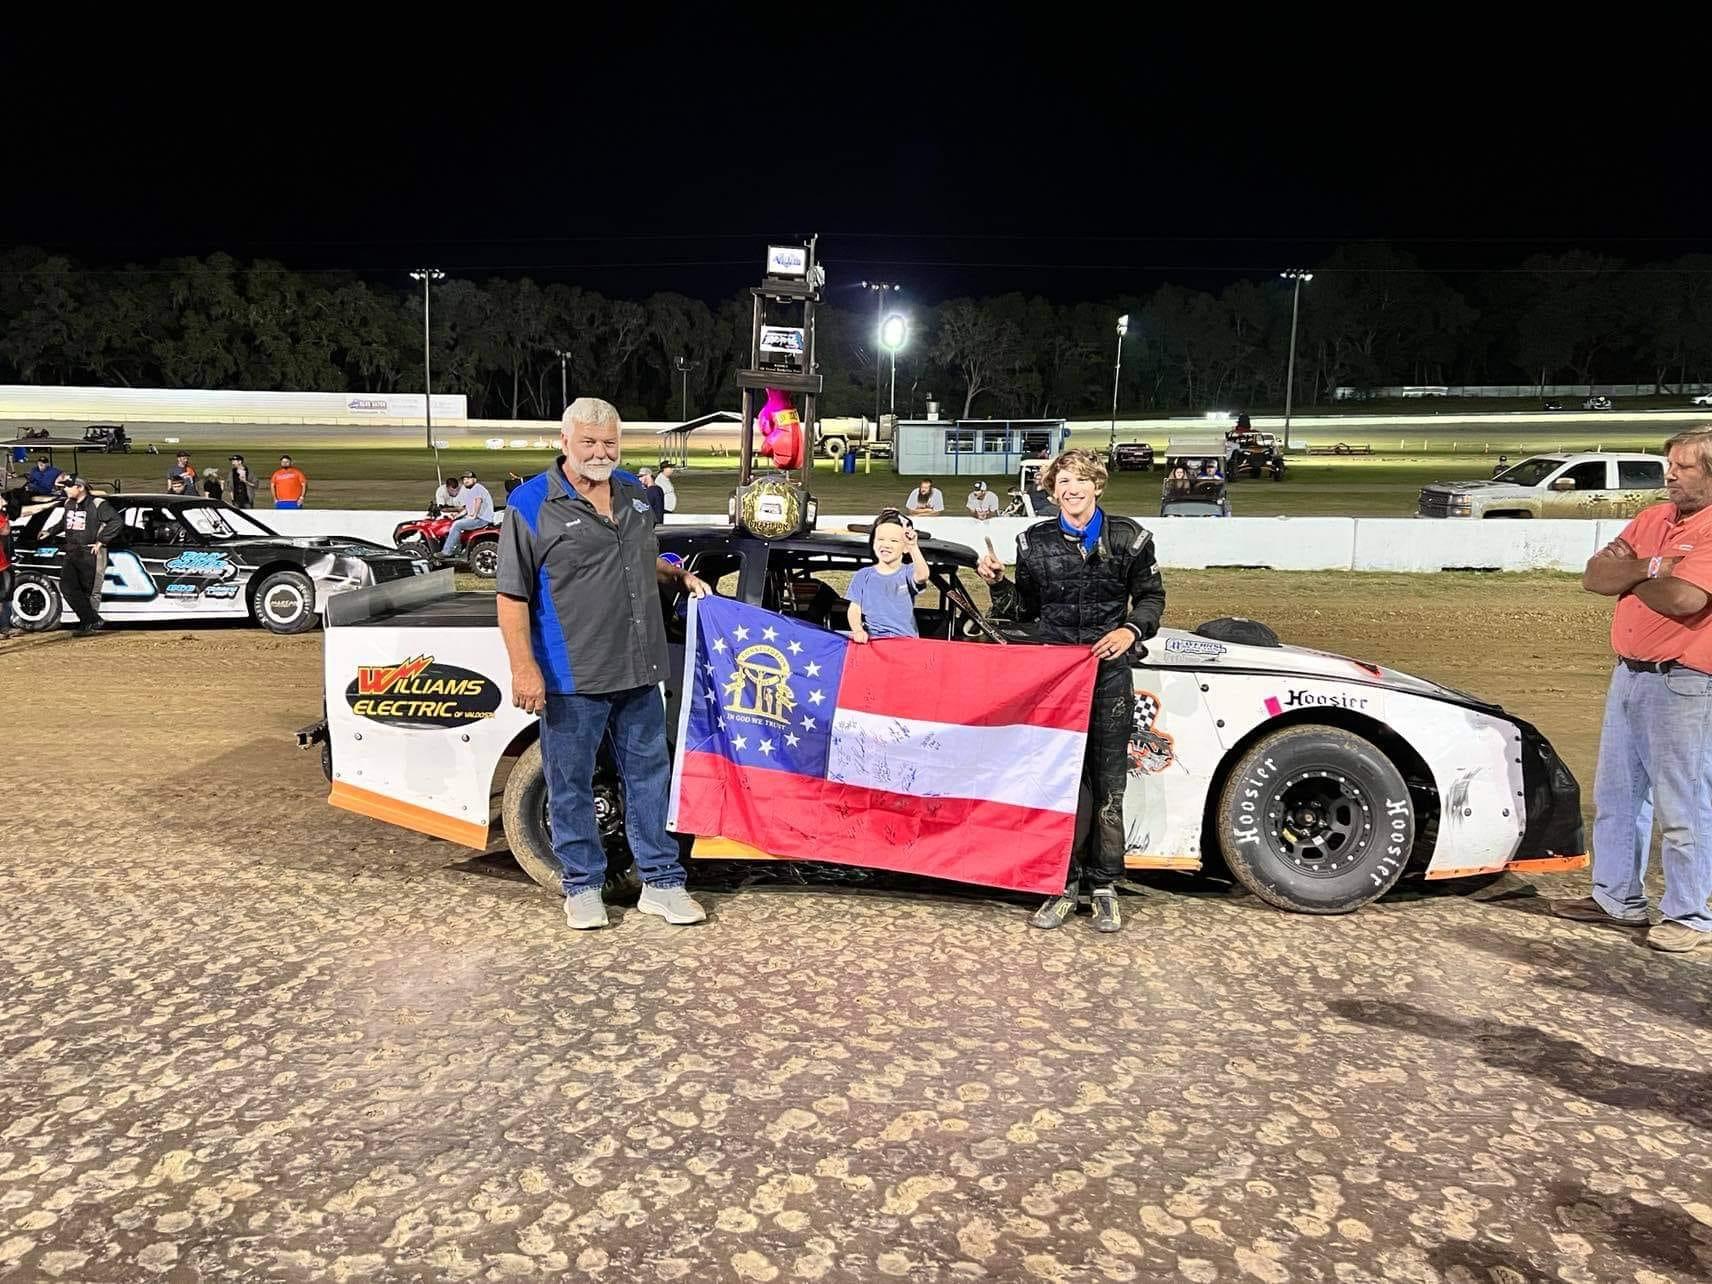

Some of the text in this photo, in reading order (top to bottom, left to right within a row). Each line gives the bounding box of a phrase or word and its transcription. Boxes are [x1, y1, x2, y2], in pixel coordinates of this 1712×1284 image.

[358, 654, 485, 695] WILLIAMS
[353, 699, 458, 717] ELECTRIC
[1283, 689, 1369, 709] Hoosier
[727, 713, 787, 731] IN GOD WE TRUST
[1233, 757, 1278, 845] Hoosier
[1369, 798, 1409, 887] Hoosier
